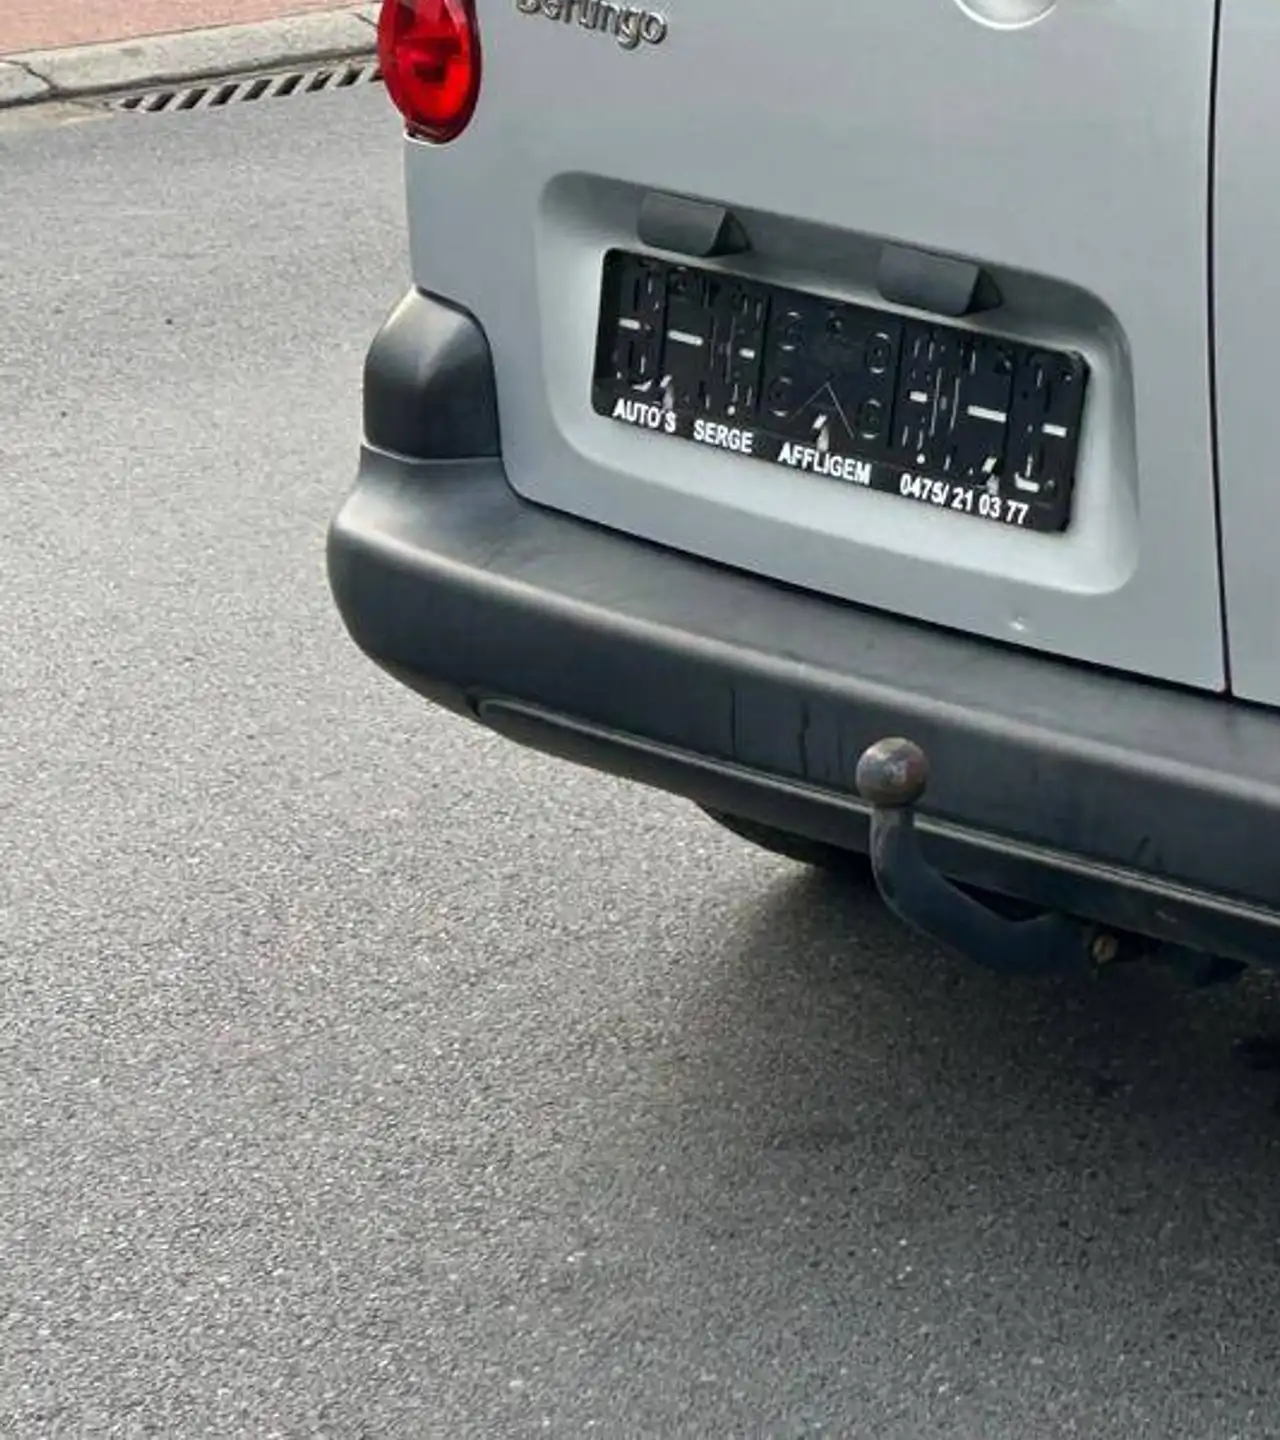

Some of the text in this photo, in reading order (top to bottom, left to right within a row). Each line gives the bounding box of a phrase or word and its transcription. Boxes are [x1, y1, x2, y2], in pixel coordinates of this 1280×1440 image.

[612, 398, 1029, 525] AUTO'S SERGE AFFLIGEM 0475/ 21 03 77
